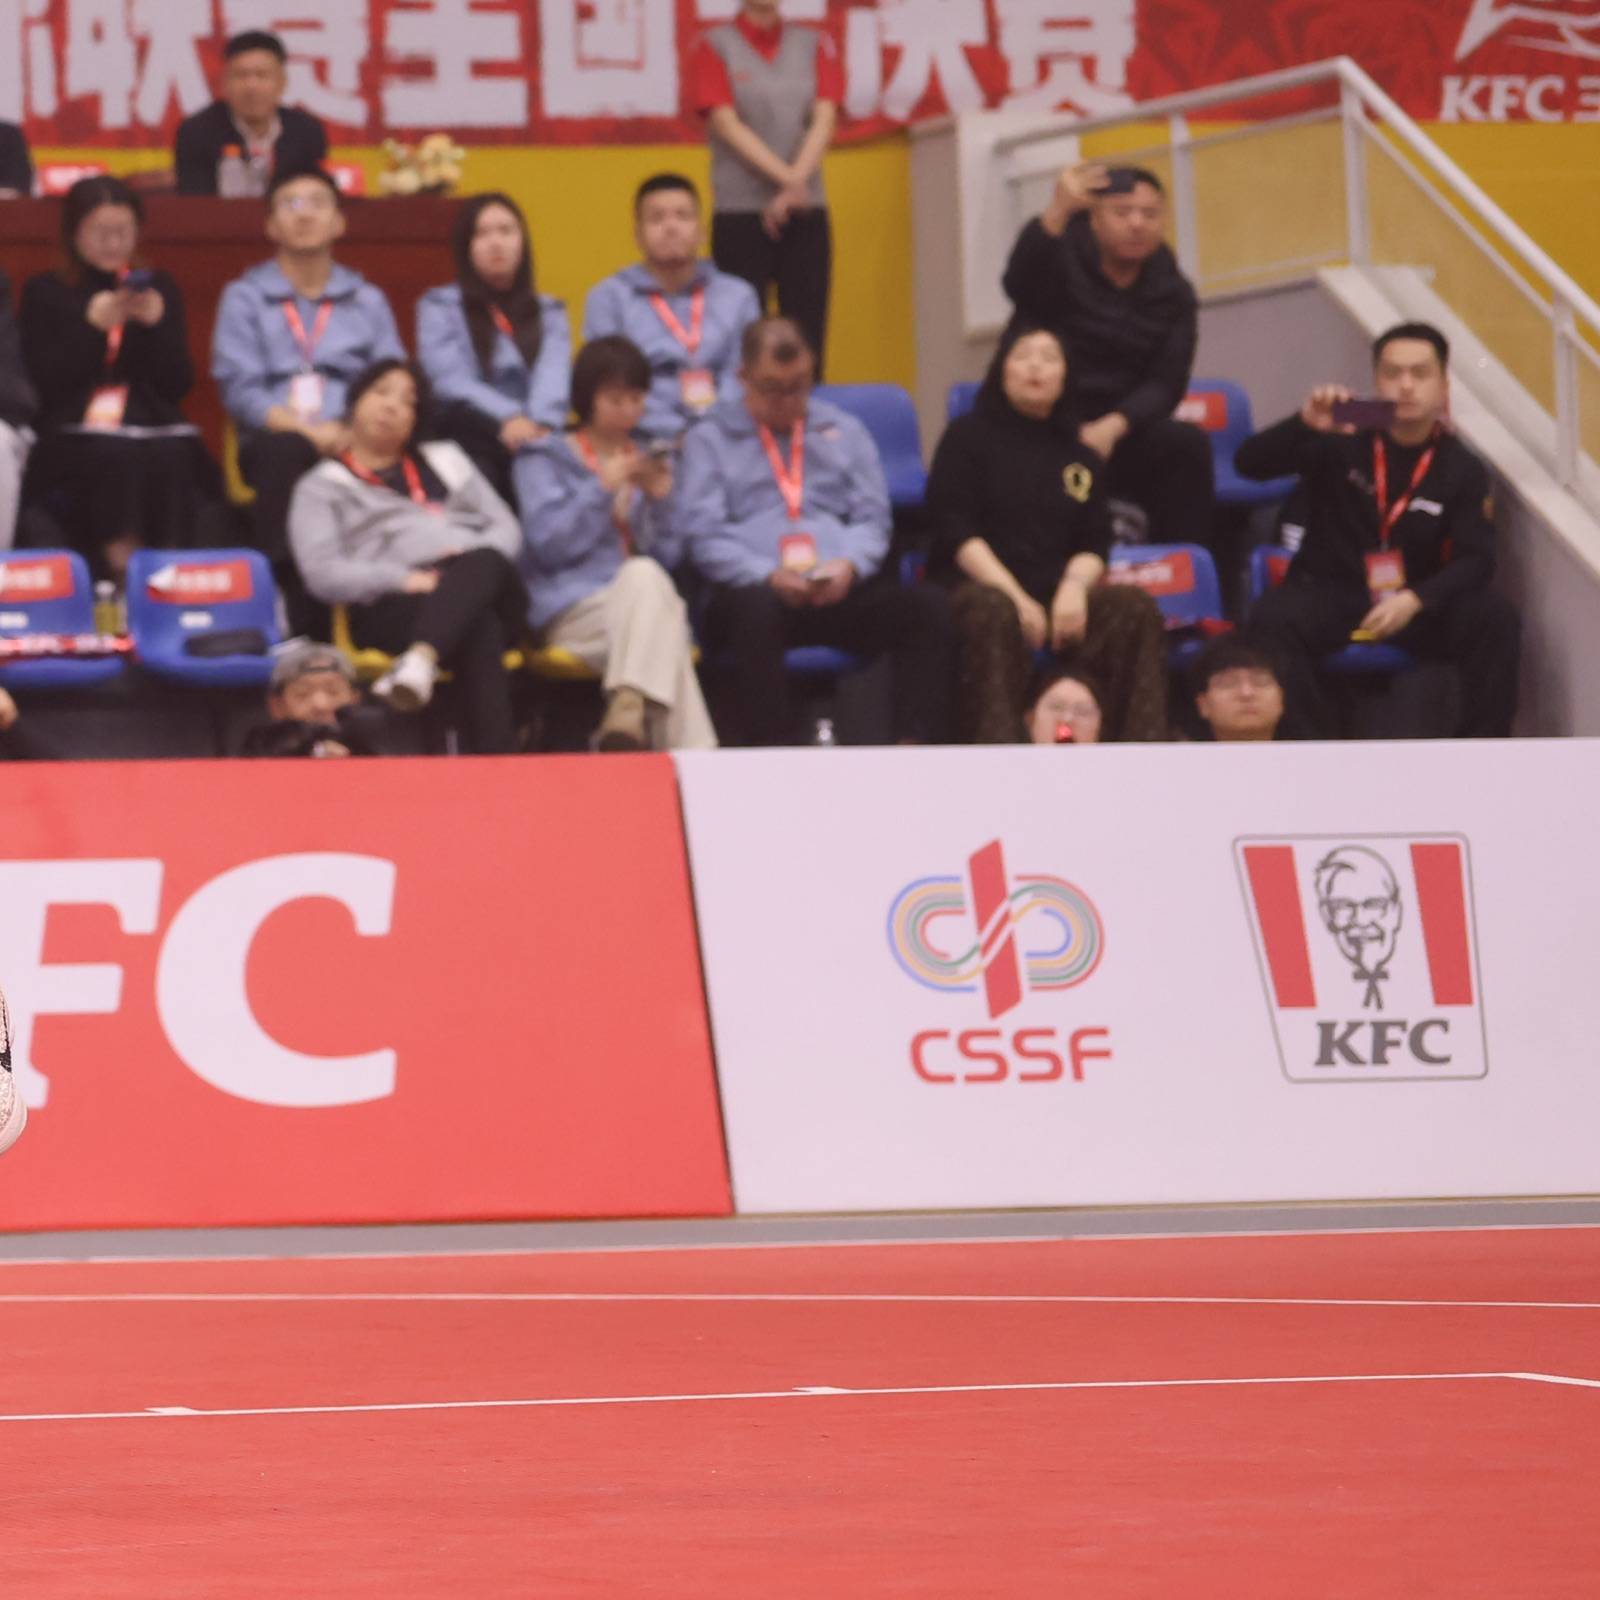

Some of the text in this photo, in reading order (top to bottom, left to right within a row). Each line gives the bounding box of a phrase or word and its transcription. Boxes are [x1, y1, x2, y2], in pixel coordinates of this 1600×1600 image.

[1439, 74, 1564, 123] KFC
[909, 1027, 1112, 1085] CSSF
[1313, 1019, 1452, 1068] KFC
